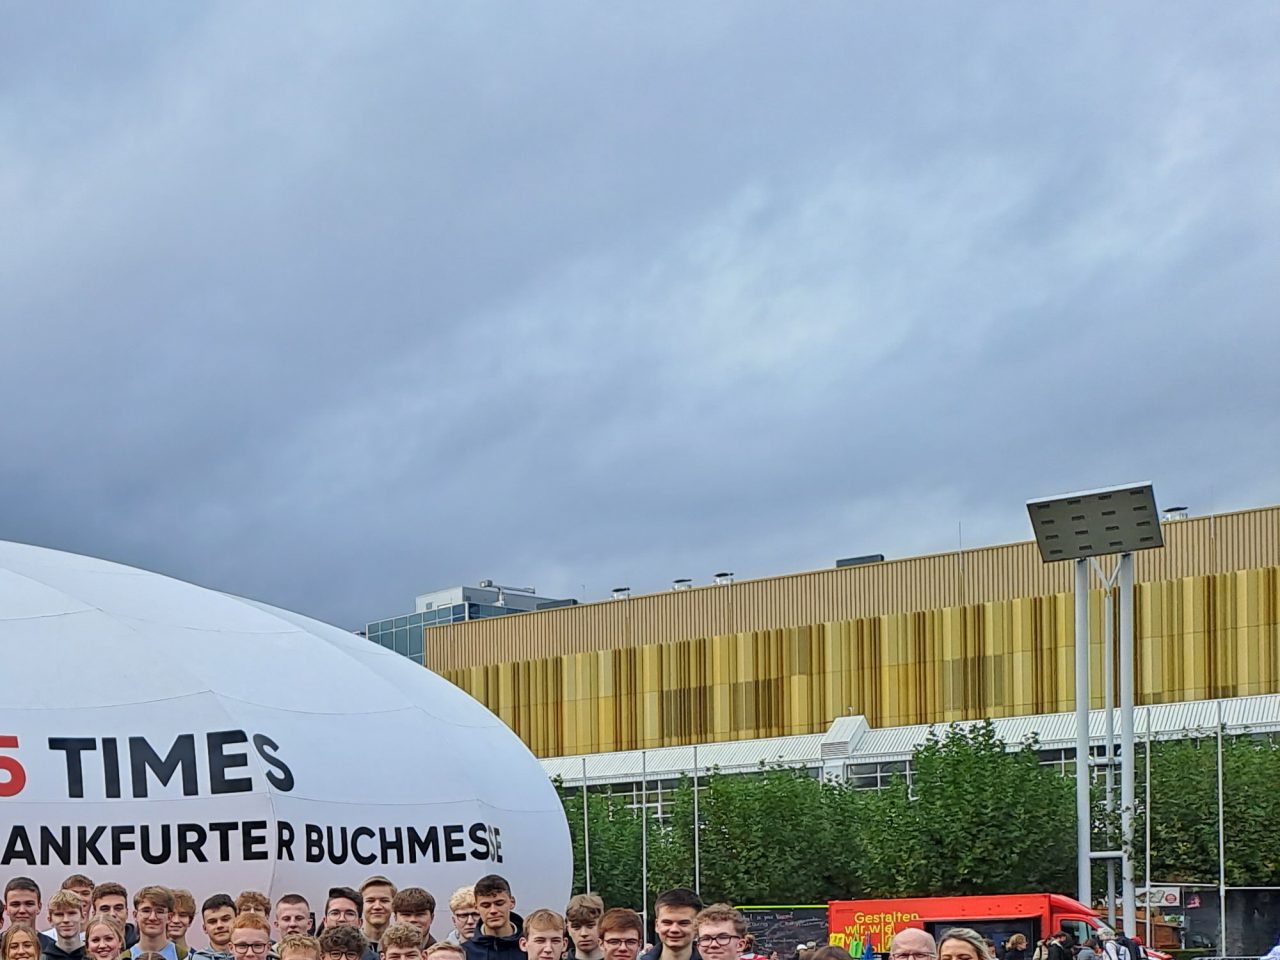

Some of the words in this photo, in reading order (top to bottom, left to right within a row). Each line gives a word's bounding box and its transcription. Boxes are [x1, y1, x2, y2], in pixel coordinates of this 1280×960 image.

[48, 729, 295, 799] TIMES
[305, 822, 504, 864] BUCHMESSE
[854, 912, 919, 924] Gestalten
